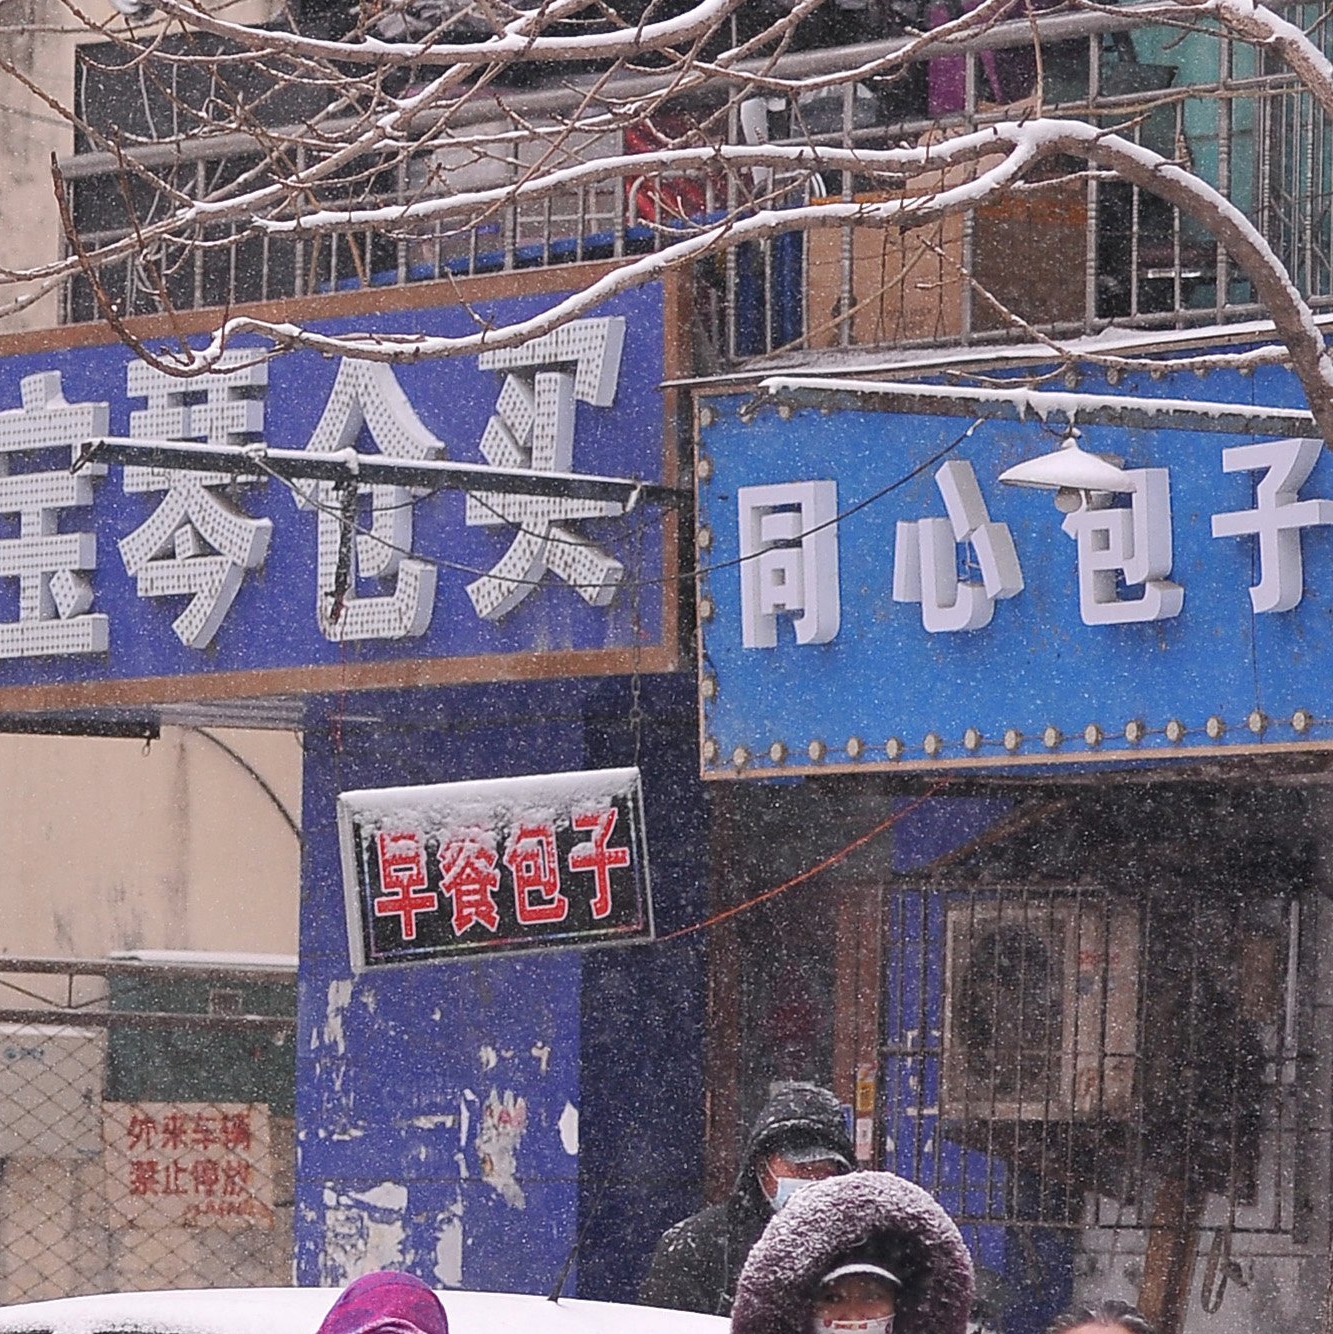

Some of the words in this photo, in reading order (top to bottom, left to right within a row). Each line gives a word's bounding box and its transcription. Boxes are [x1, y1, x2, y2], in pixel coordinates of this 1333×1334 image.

[738, 438, 1333, 648] 同心包子
[374, 807, 630, 940] 早餐包子
